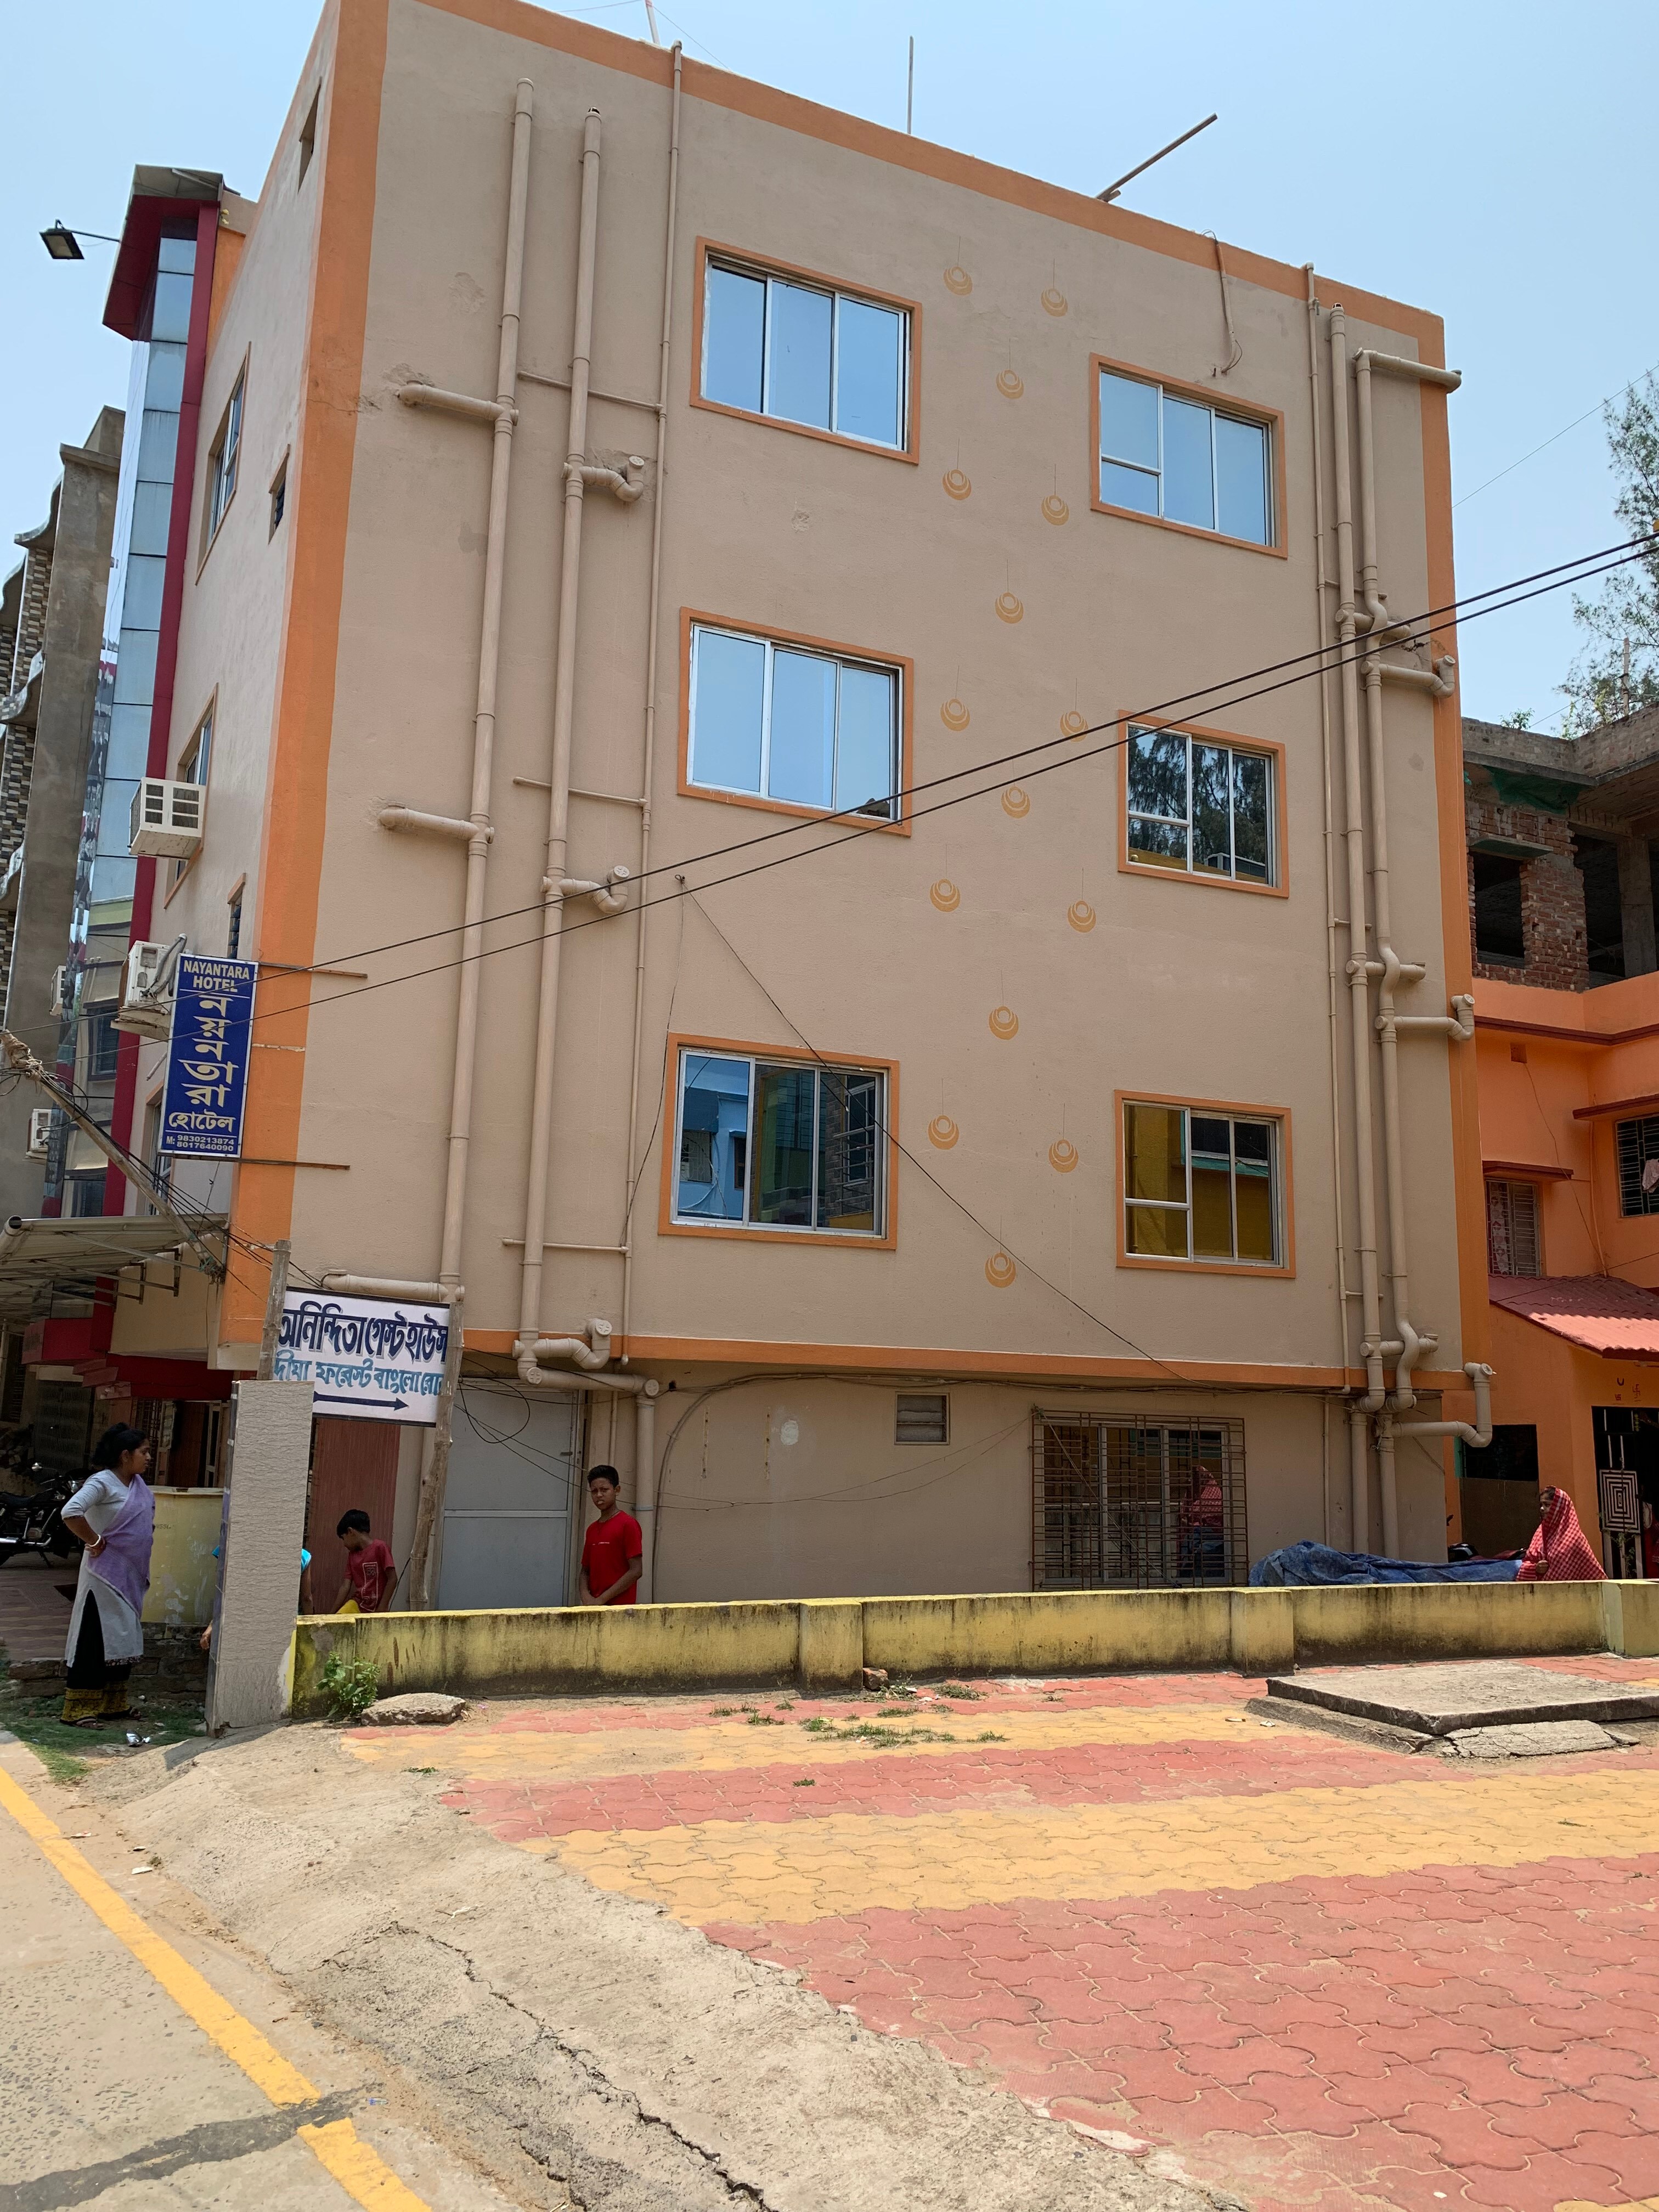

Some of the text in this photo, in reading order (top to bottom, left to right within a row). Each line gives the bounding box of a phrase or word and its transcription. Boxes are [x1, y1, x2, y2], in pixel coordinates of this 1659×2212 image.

[183, 960, 250, 980] NAYANTARA
[193, 975, 238, 992] HOTEL
[168, 1109, 236, 1133] হোটেল
[166, 1135, 234, 1145] M: 9830213874
[176, 1141, 234, 1152] 8017640090
[278, 1300, 368, 1355] অনিন্দিতা
[365, 1311, 407, 1358] গেস্ট
[420, 1372, 444, 1396] রো
